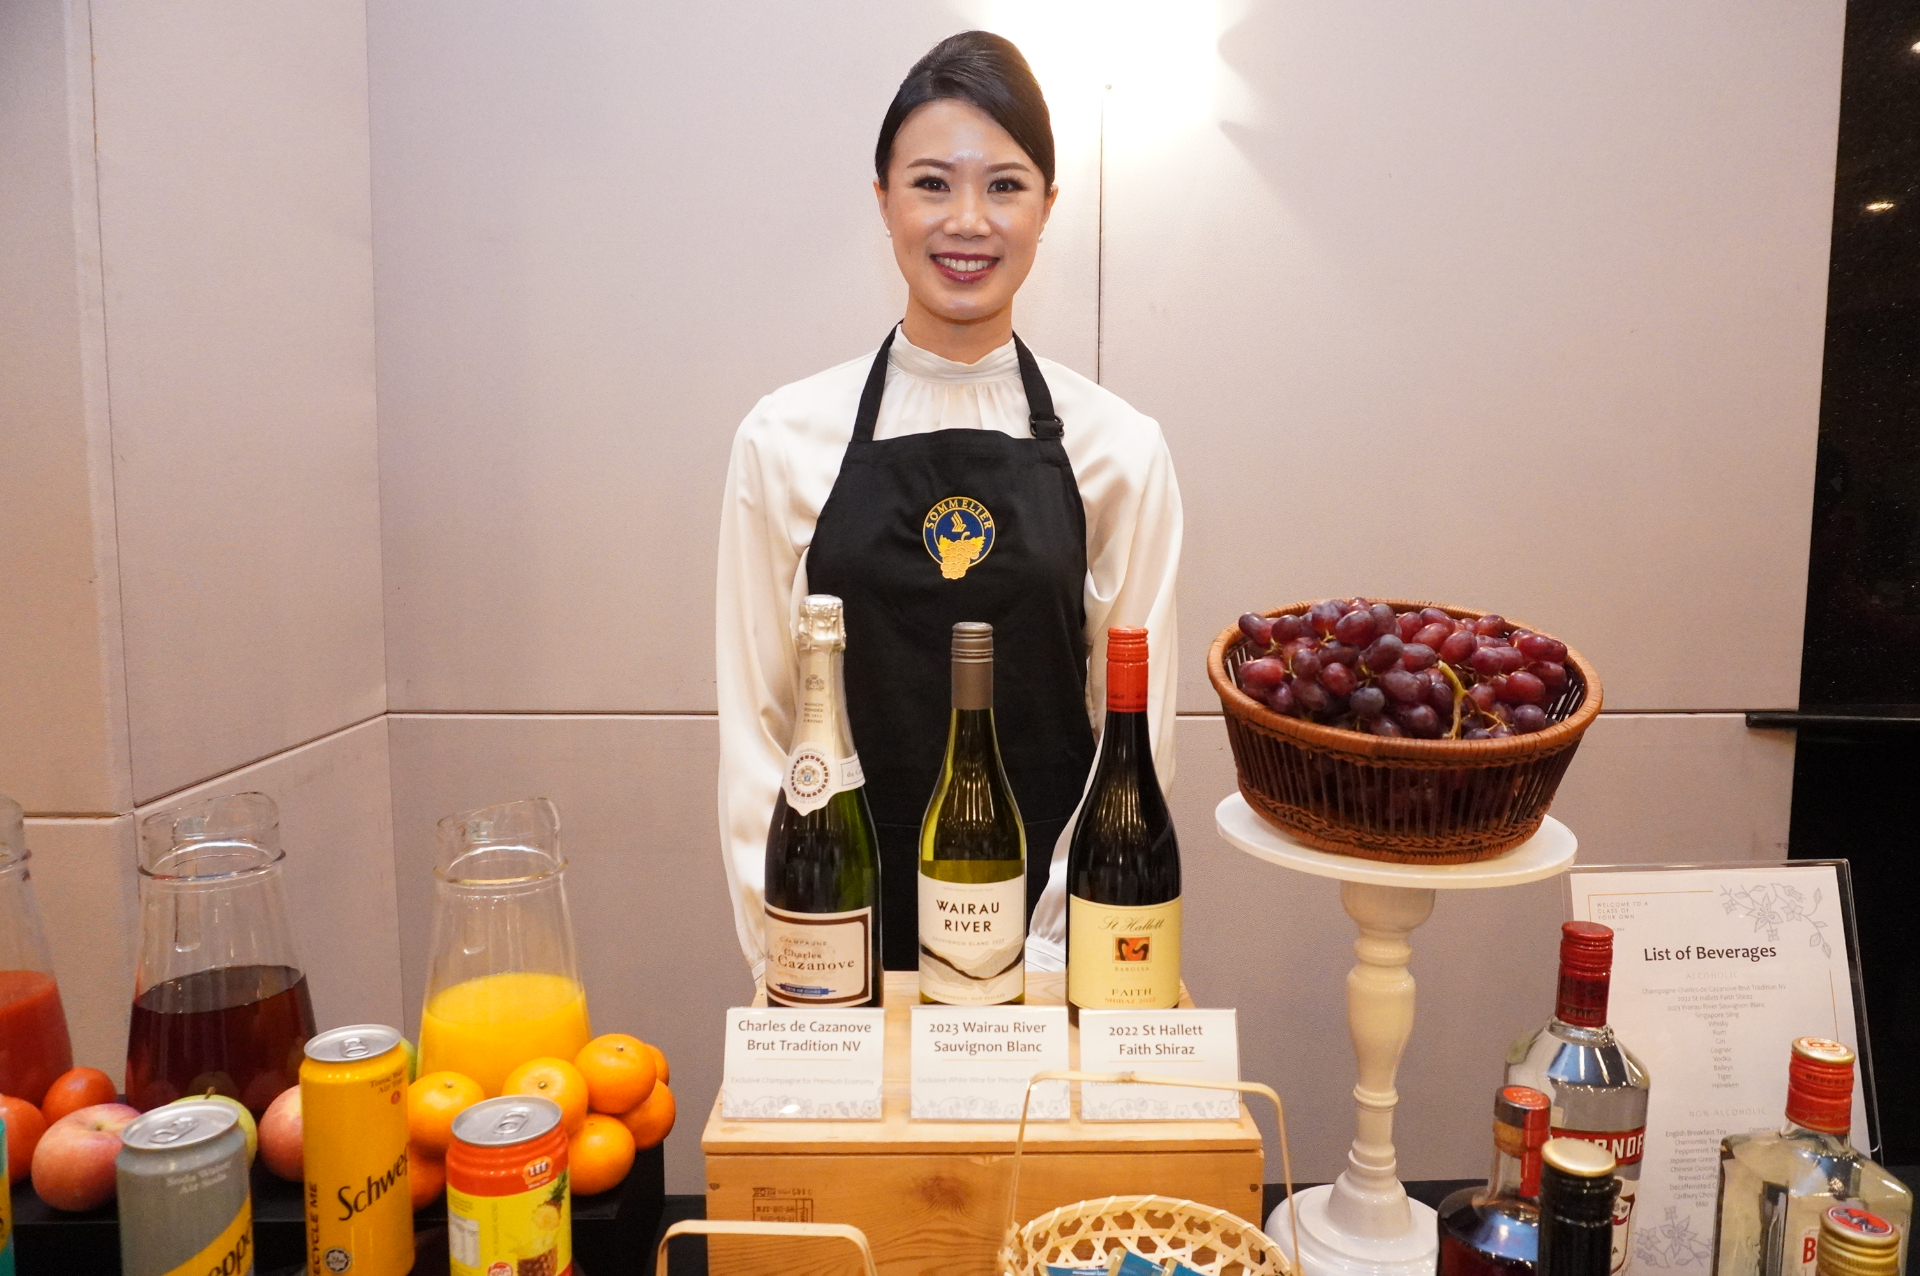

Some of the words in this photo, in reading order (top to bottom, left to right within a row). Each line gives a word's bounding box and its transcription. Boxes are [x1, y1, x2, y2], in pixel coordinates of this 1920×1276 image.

[926, 499, 992, 529] SOMMELIER
[936, 899, 1000, 914] WAIRAU
[944, 919, 992, 932] RIVER
[1120, 916, 1165, 932] Hallett
[784, 948, 822, 960] Charles
[1644, 947, 1672, 961] List
[1675, 946, 1692, 960] of
[1696, 946, 1777, 962] Beverages
[778, 955, 855, 970] Cazanove
[1686, 970, 1738, 979] ALCOHOLIC
[1112, 988, 1152, 996] FAITH
[738, 1020, 786, 1032] Charles
[790, 1020, 806, 1032] de
[810, 1021, 872, 1032] Cazanove
[930, 1023, 959, 1035] 2023
[963, 1022, 1009, 1032] Wairau
[1013, 1022, 1046, 1032] River
[1110, 1026, 1138, 1036] 2022
[1142, 1024, 1156, 1036] St
[1160, 1024, 1204, 1036] Hallett
[748, 1040, 775, 1050] Brut
[779, 1040, 838, 1052] Tradition
[842, 1041, 861, 1052] NV
[934, 1040, 1002, 1055] Sauvignon
[1007, 1041, 1042, 1052] Blanc
[1120, 1044, 1151, 1055] Faith
[1156, 1044, 1195, 1055] Shiraz
[762, 1077, 800, 1086] Champagne
[844, 1077, 874, 1086] Economy
[528, 1161, 548, 1177] LEE
[310, 1212, 320, 1276] ECYCLE
